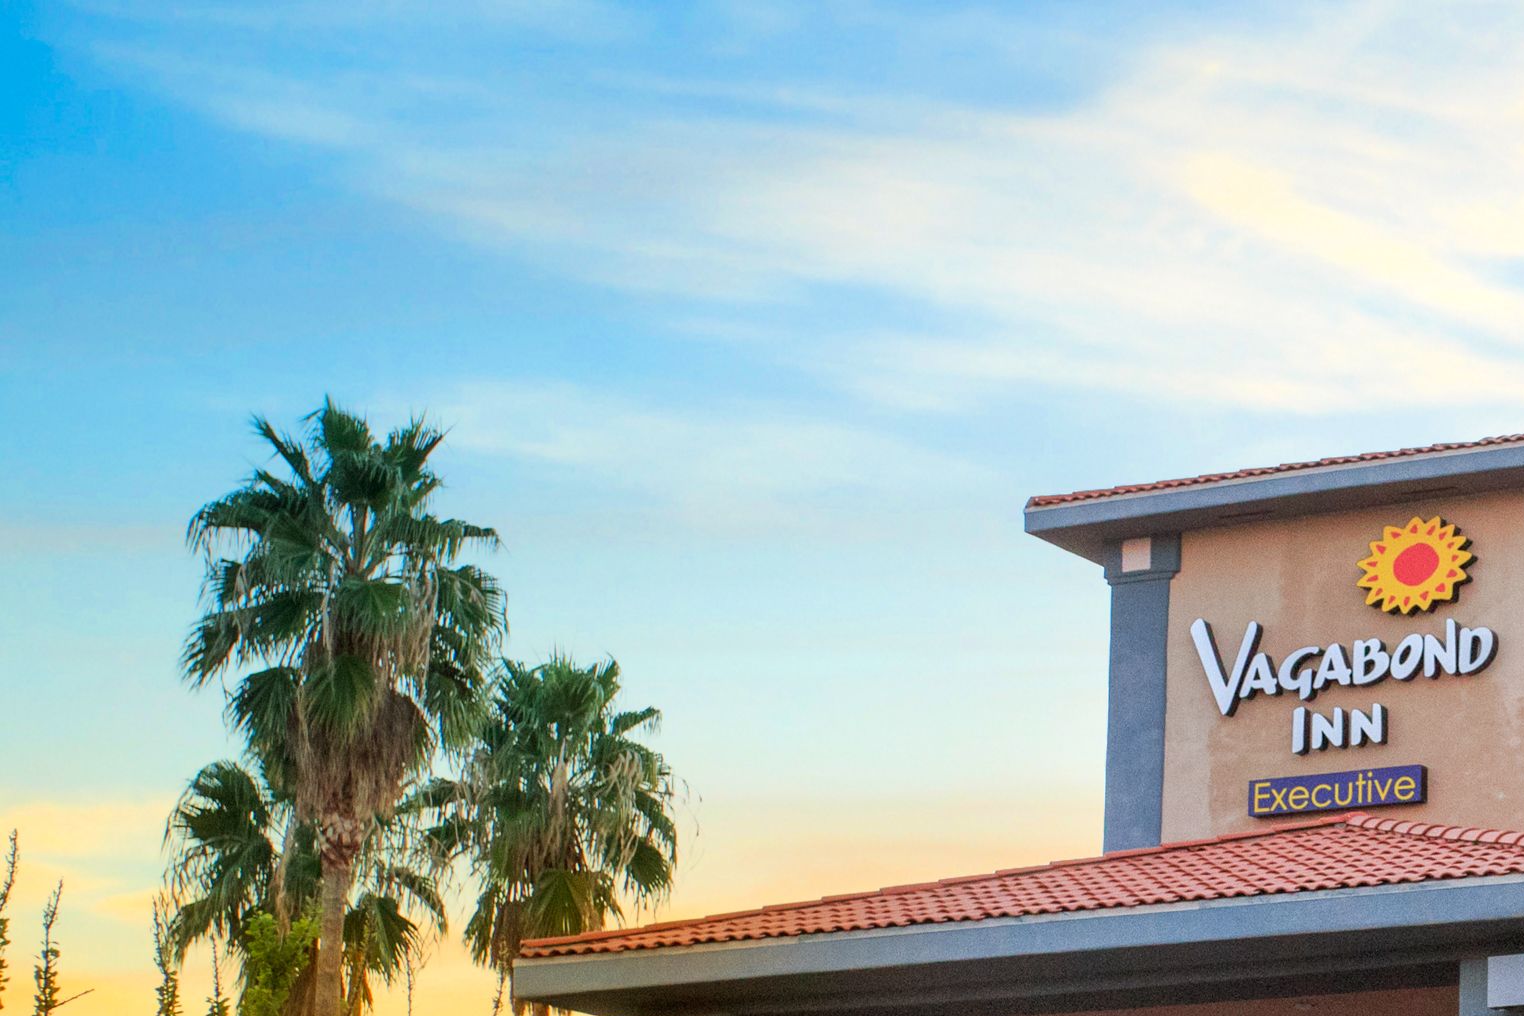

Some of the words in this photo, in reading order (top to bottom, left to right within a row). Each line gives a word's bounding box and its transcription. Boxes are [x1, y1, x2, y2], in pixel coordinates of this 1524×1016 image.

[1189, 617, 1497, 717] VAGABOND
[1291, 702, 1387, 755] INN
[1252, 771, 1416, 814] Executive
